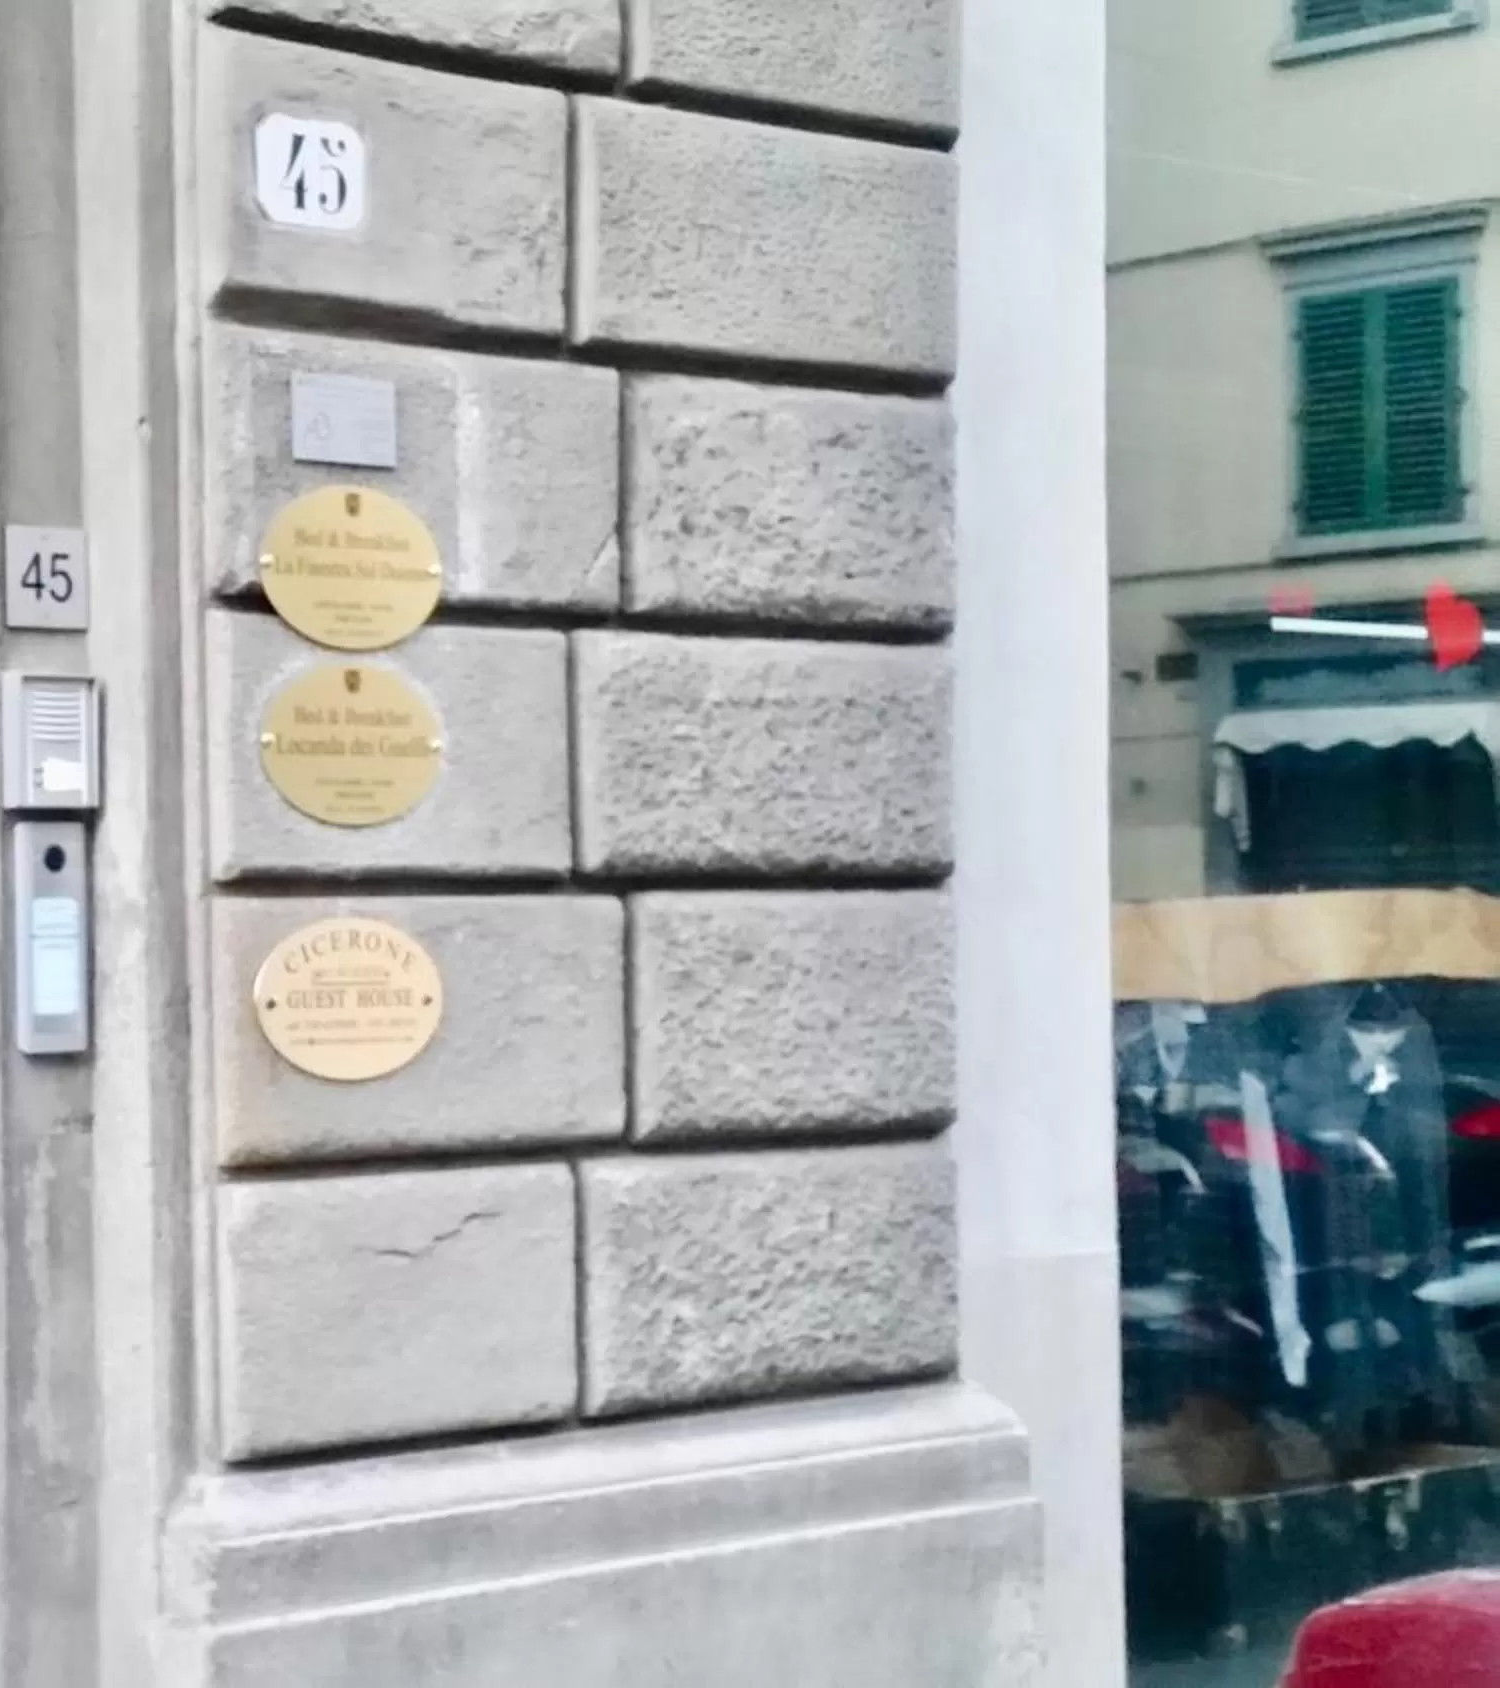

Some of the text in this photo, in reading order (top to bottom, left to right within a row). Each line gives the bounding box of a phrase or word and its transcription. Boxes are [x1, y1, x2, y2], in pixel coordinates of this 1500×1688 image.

[280, 133, 347, 215] 45
[21, 551, 73, 603] 45
[283, 928, 417, 974] CICERONE
[285, 987, 414, 1009] GUEST HOUSE
